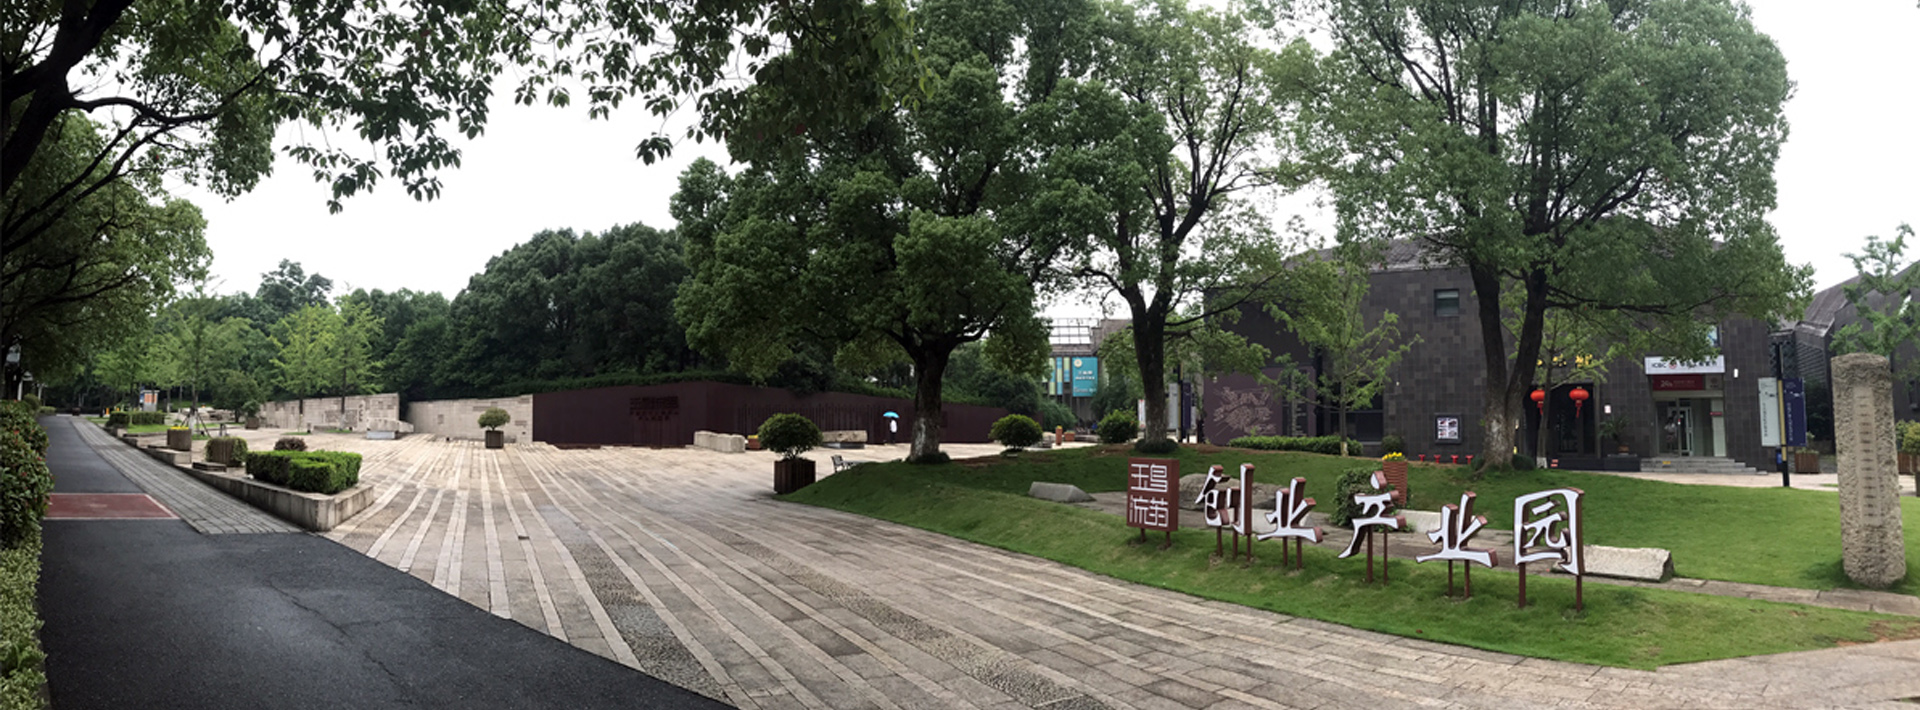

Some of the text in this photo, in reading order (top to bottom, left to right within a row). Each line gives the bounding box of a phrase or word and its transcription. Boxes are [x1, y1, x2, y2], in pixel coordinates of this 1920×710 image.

[1131, 463, 1168, 493] 玉鸟
[1129, 494, 1169, 528] 流苏
[1195, 463, 1581, 576] 创业产业园
